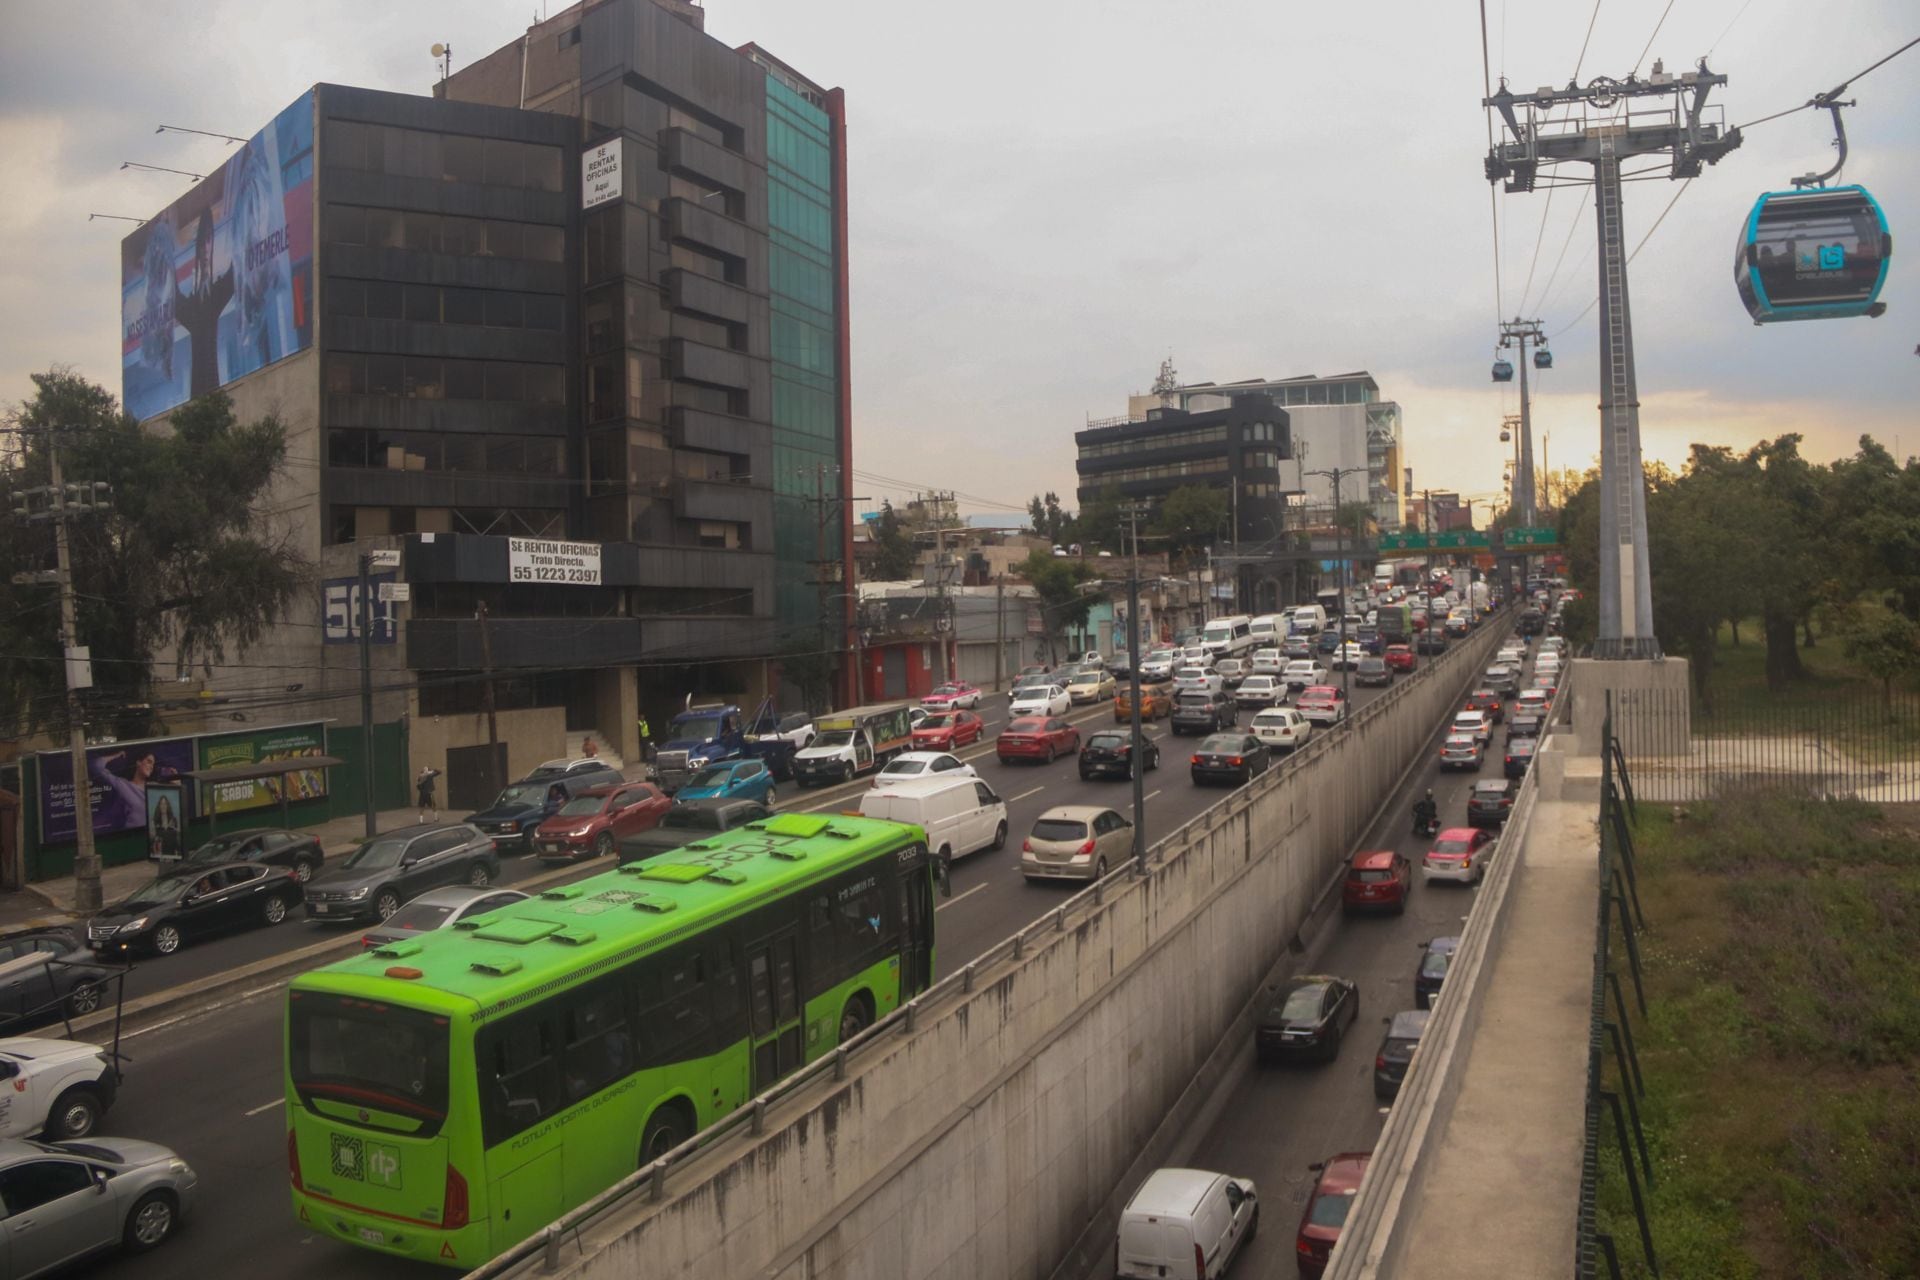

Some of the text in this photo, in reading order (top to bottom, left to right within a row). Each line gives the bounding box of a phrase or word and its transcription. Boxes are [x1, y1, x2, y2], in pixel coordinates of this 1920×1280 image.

[598, 148, 606, 158] SE
[589, 154, 615, 171] RENTAN
[586, 164, 617, 182] OFICINAS
[511, 541, 599, 557] SE RENTAN OFICINAS
[530, 554, 553, 566] Trato
[513, 566, 598, 582] 55 1223 2397
[222, 785, 255, 802] SABOR
[896, 846, 917, 863] 7033
[511, 1123, 552, 1152] FLOTILLA
